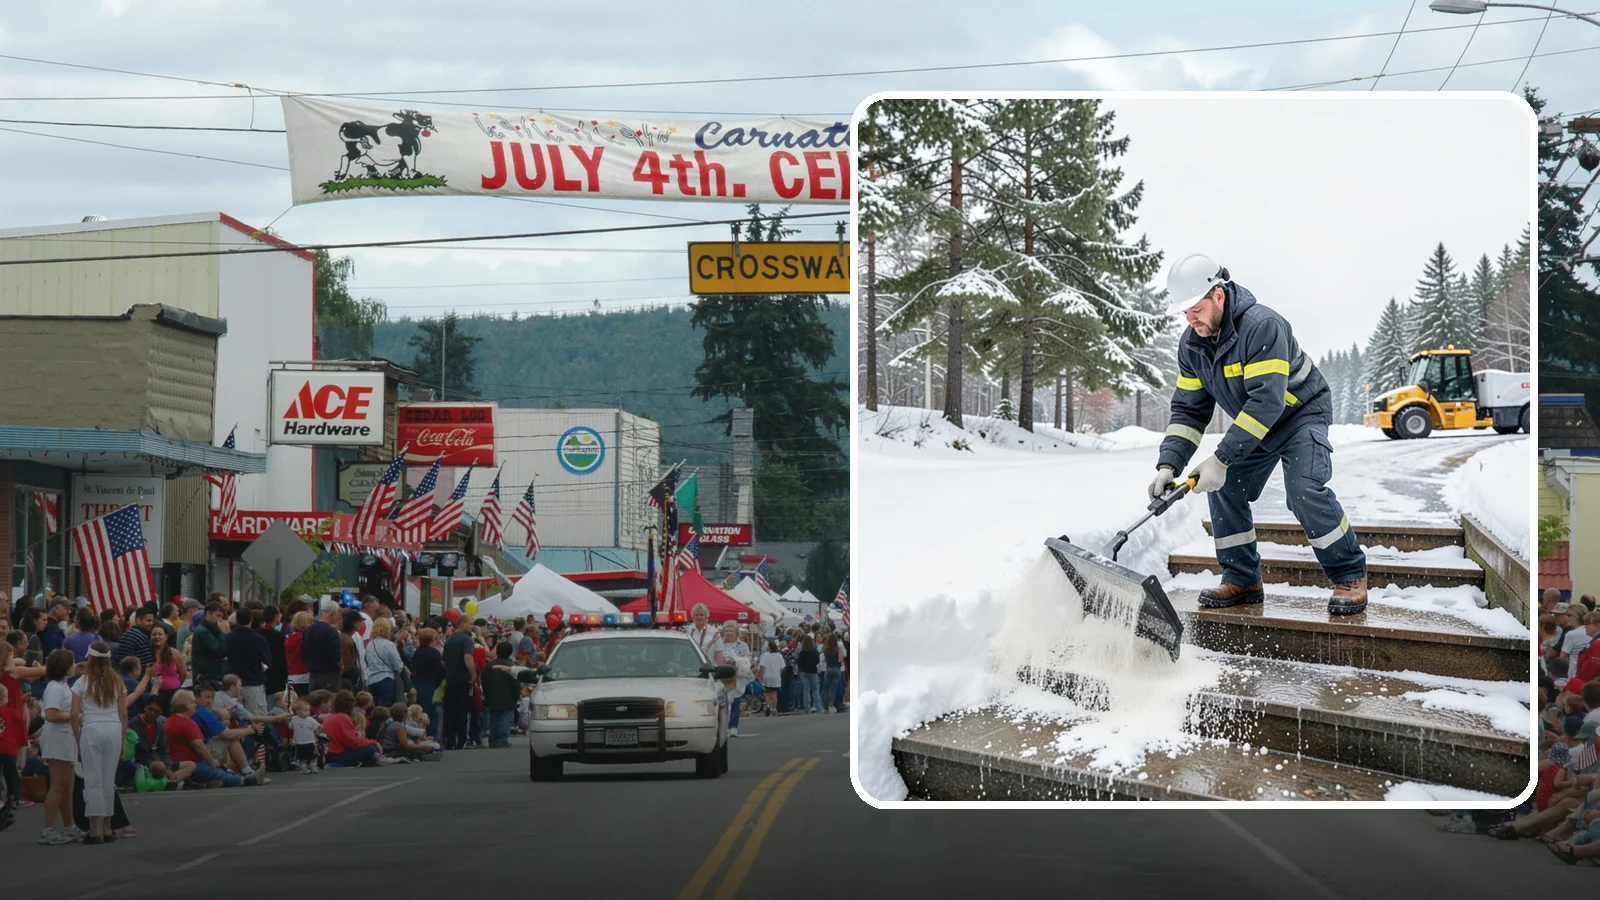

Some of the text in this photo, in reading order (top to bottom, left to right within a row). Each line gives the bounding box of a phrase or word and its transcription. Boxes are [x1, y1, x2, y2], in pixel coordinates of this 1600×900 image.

[695, 121, 850, 150] Carnat
[481, 141, 604, 192] JULY
[632, 149, 746, 198] 4th.
[697, 254, 850, 280] CROSSWA
[282, 380, 373, 420] ACE
[405, 409, 485, 422] CEDAR LOG
[283, 421, 371, 437] Hardware
[416, 428, 477, 447] Coca-Cola
[353, 467, 384, 481] Simpl
[83, 484, 155, 496] St. Vincent de Paul
[212, 516, 331, 536] HRDARE
[688, 526, 741, 535] CRNATION
[699, 535, 730, 543] GLASS
